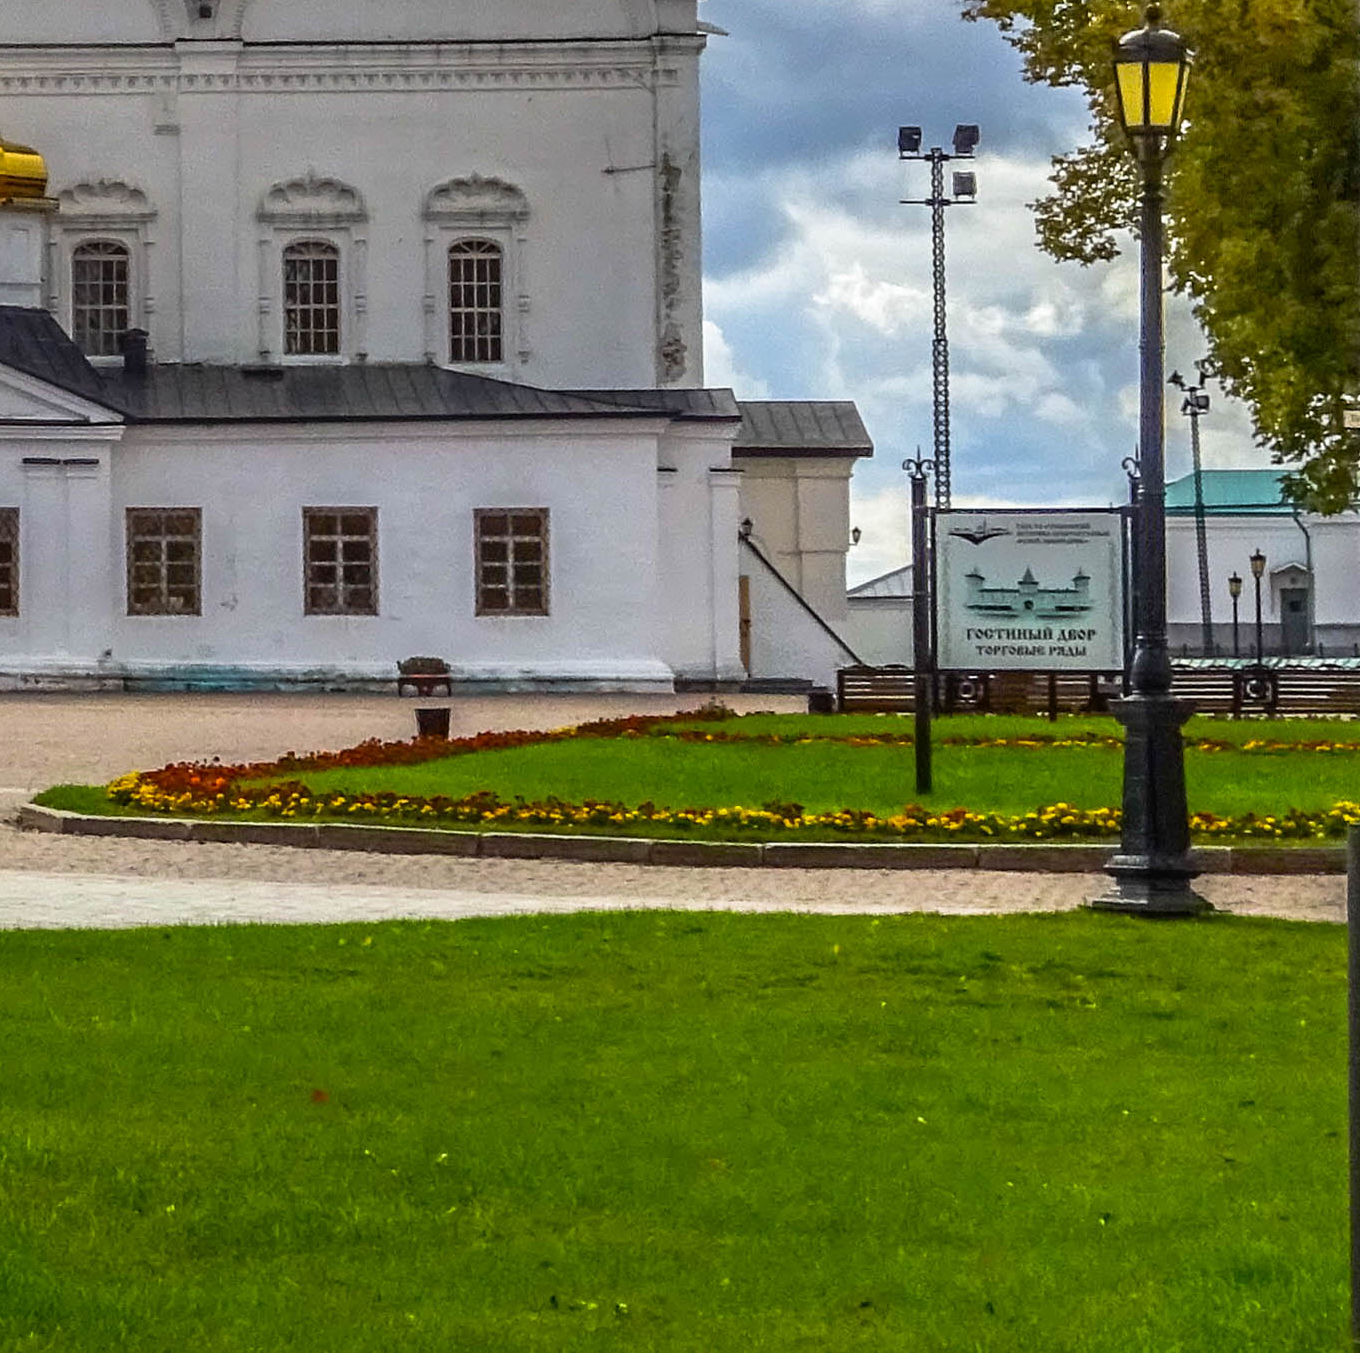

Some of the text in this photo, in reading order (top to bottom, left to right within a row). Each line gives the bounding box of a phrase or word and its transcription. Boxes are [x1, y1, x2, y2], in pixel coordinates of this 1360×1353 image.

[966, 626, 1097, 642] ГОСТИНЫЙ ДВОР
[976, 645, 1087, 657] ТОРГОВЫЕ РЯДЫ
